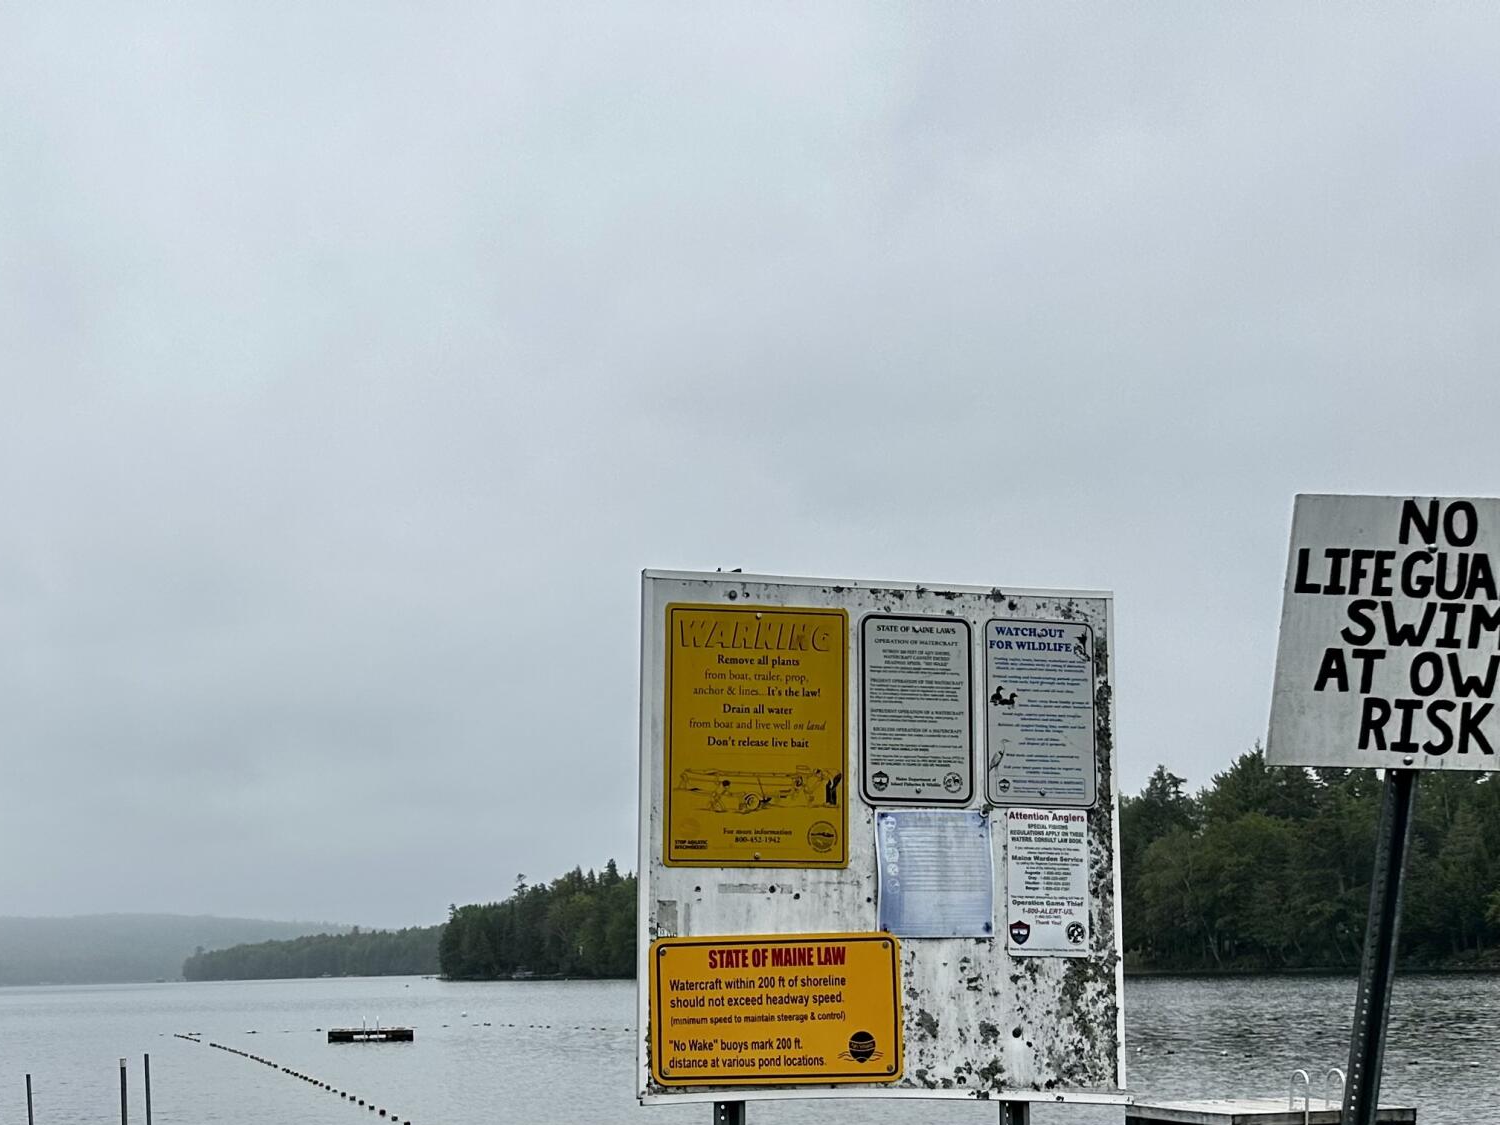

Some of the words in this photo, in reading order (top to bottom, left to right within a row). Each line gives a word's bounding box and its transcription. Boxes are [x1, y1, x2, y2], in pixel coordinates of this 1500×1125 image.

[1399, 501, 1478, 547] NO
[1294, 548, 1498, 600] LIFEGUA
[1340, 599, 1500, 649] SWIM
[680, 620, 830, 652] WARNING
[995, 627, 1037, 637] WATCH
[1039, 629, 1064, 638] OUT
[989, 640, 1013, 649] FOR
[1016, 642, 1072, 652] WILDLIFE
[718, 654, 755, 665] Remove
[757, 656, 768, 665] all
[772, 656, 800, 668] plants
[705, 670, 726, 679] from
[1314, 648, 1386, 694] AT
[1410, 652, 1500, 698] OW
[693, 685, 724, 695] anchor
[726, 686, 736, 696] &
[785, 687, 799, 697] the
[802, 688, 821, 697] law!
[723, 704, 750, 714] Drain
[753, 704, 764, 714] all
[768, 705, 793, 714] water
[689, 718, 710, 728] from
[714, 718, 733, 729] boat
[736, 719, 752, 729] and
[755, 719, 770, 729] live
[773, 719, 791, 729] well
[807, 720, 826, 731] land
[1358, 697, 1495, 755] RISK
[707, 736, 735, 746] Don't
[738, 737, 769, 747] release
[772, 737, 788, 748] live
[791, 738, 809, 748] bait
[1009, 811, 1049, 820] Attention
[1052, 813, 1084, 823] Anglers
[708, 949, 749, 969] STATE
[752, 948, 768, 968] OF
[771, 947, 814, 967] MAINE
[816, 947, 846, 966] LAW
[670, 978, 722, 992] Watercraft
[725, 978, 755, 990] within
[758, 977, 775, 988] 200
[778, 977, 785, 988] ft
[788, 976, 798, 987] of
[800, 976, 846, 987] shoreline
[670, 996, 705, 1008] should
[708, 996, 725, 1007] not
[727, 995, 763, 1006] exceed
[766, 993, 809, 1007] headway
[812, 992, 845, 1006] speed.
[671, 1016, 708, 1026] (minimum
[710, 1015, 733, 1025] speed
[734, 1015, 742, 1024] to
[744, 1013, 775, 1023] maintain
[777, 1013, 808, 1023] steerage
[810, 1012, 816, 1021] &
[817, 1011, 846, 1022] control)
[669, 1039, 686, 1051] "No
[689, 1039, 718, 1050] Wake"
[720, 1038, 748, 1053] buoys
[751, 1038, 774, 1050] mark
[776, 1038, 792, 1050] 200
[794, 1038, 803, 1049] ft.
[669, 1057, 708, 1069] distance
[711, 1057, 719, 1068] at
[722, 1056, 755, 1068] various
[758, 1055, 780, 1069] pond
[783, 1055, 826, 1067] locations.
